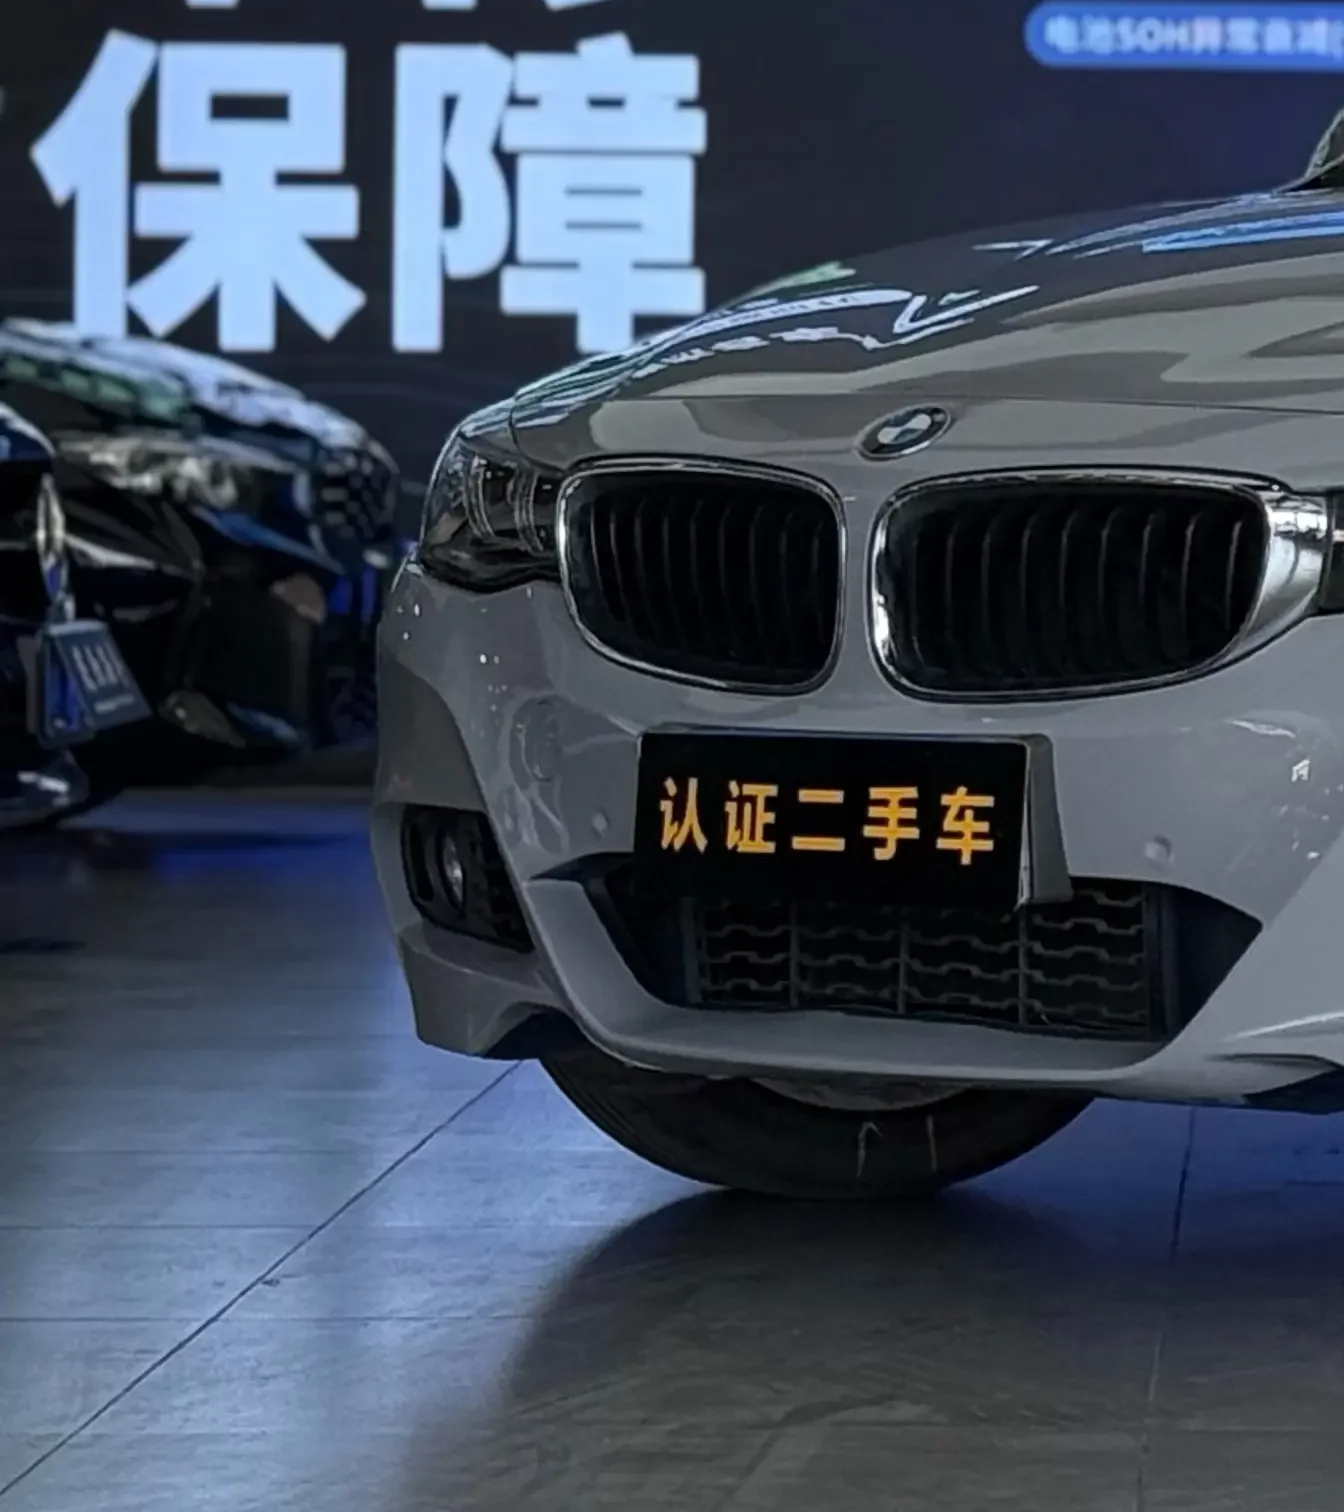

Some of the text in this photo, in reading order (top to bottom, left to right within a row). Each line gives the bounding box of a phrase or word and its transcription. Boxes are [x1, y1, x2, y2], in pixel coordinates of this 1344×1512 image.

[30, 29, 706, 353] 保障
[660, 777, 995, 865] 认证二手车
